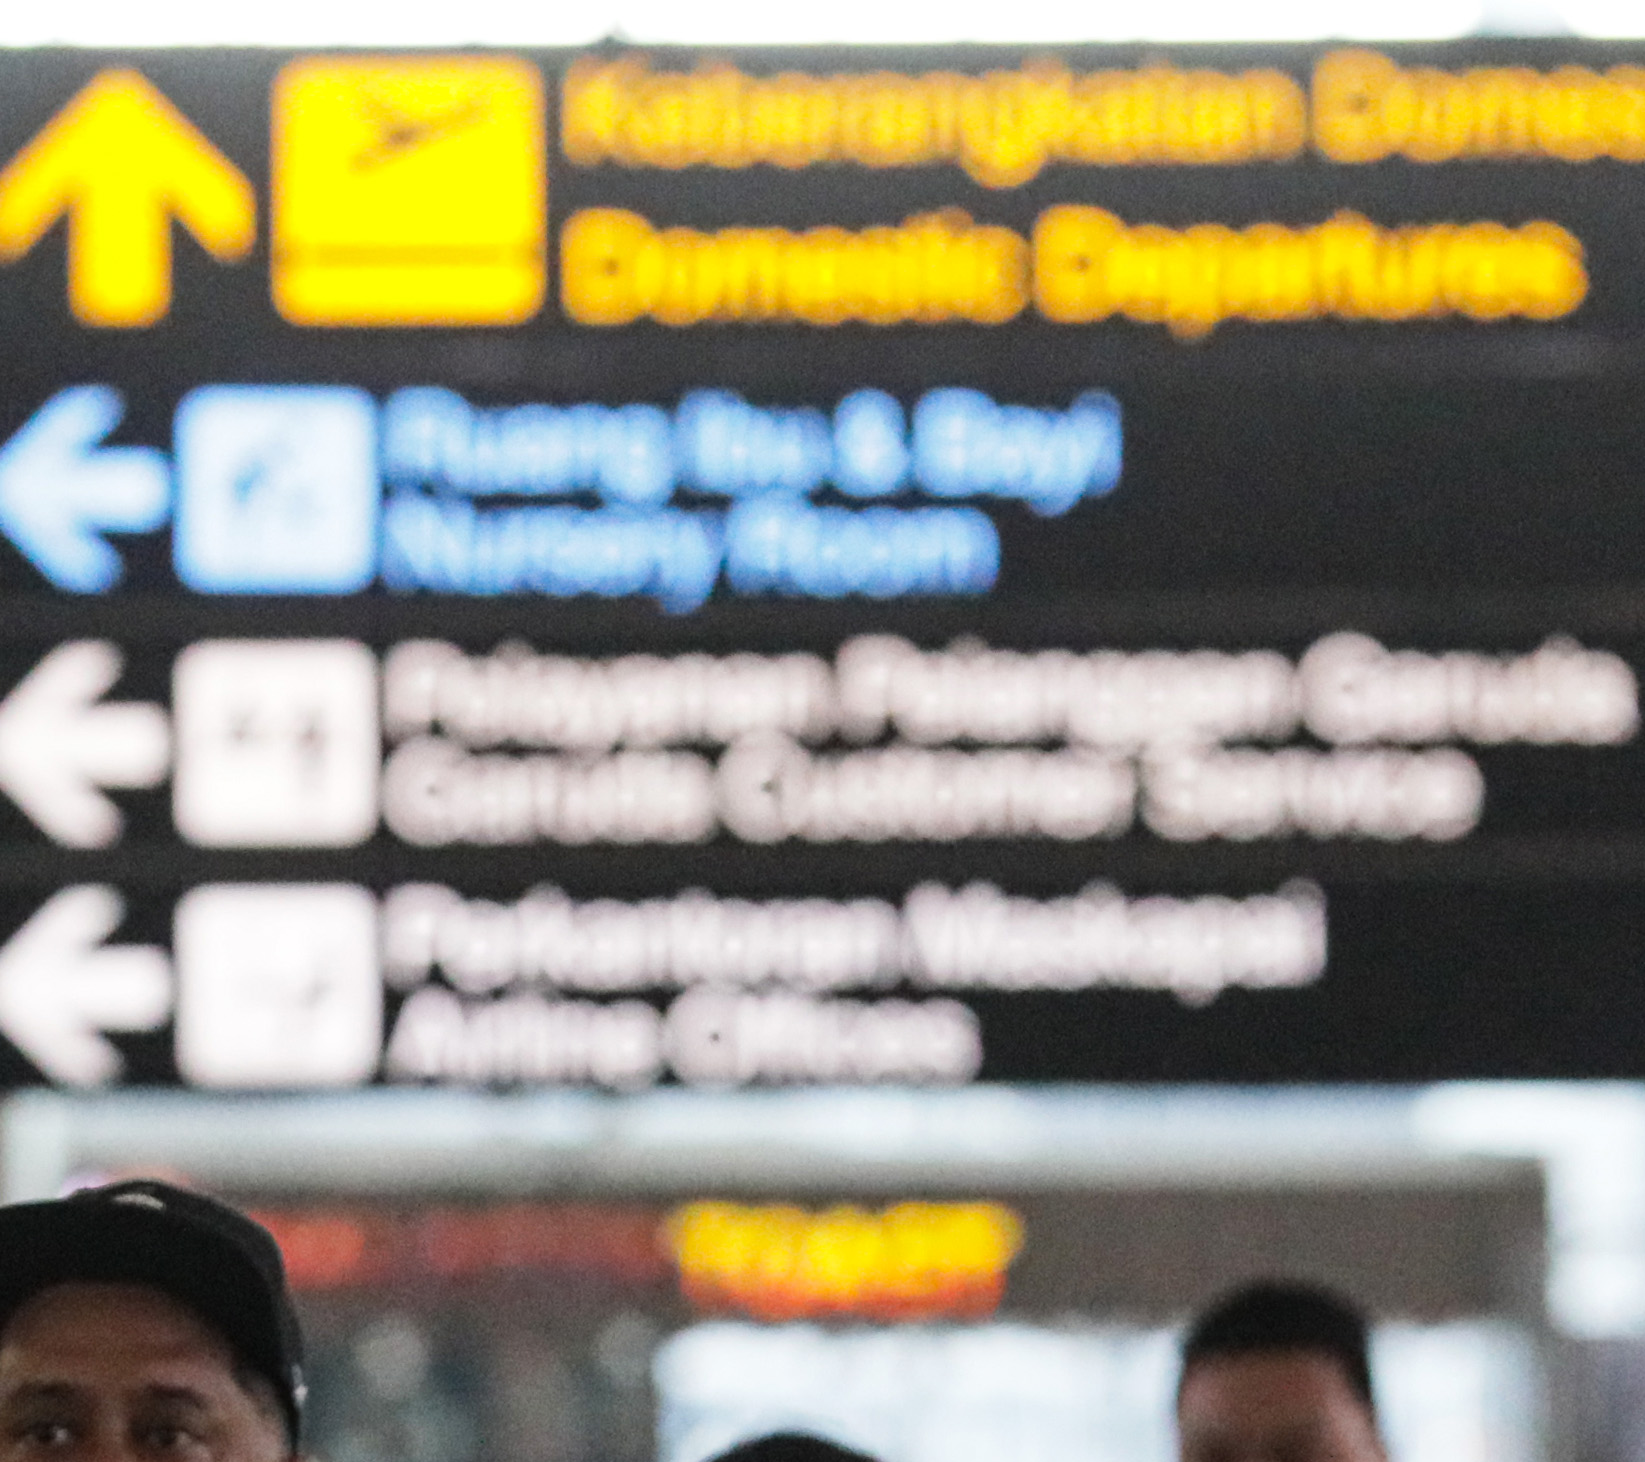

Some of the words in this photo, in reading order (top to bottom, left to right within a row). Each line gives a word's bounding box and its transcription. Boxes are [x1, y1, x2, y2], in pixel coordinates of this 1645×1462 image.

[561, 206, 1031, 325] Domestic
[1033, 205, 1588, 340] Departures
[381, 488, 715, 615] Nursery
[724, 488, 1001, 599] Room
[1300, 633, 1637, 745] Garuda
[383, 733, 715, 845] Garuda
[716, 728, 1137, 842] Customer
[1139, 728, 1485, 842] Service
[383, 986, 662, 1088] Airline
[665, 982, 984, 1088] Offices
